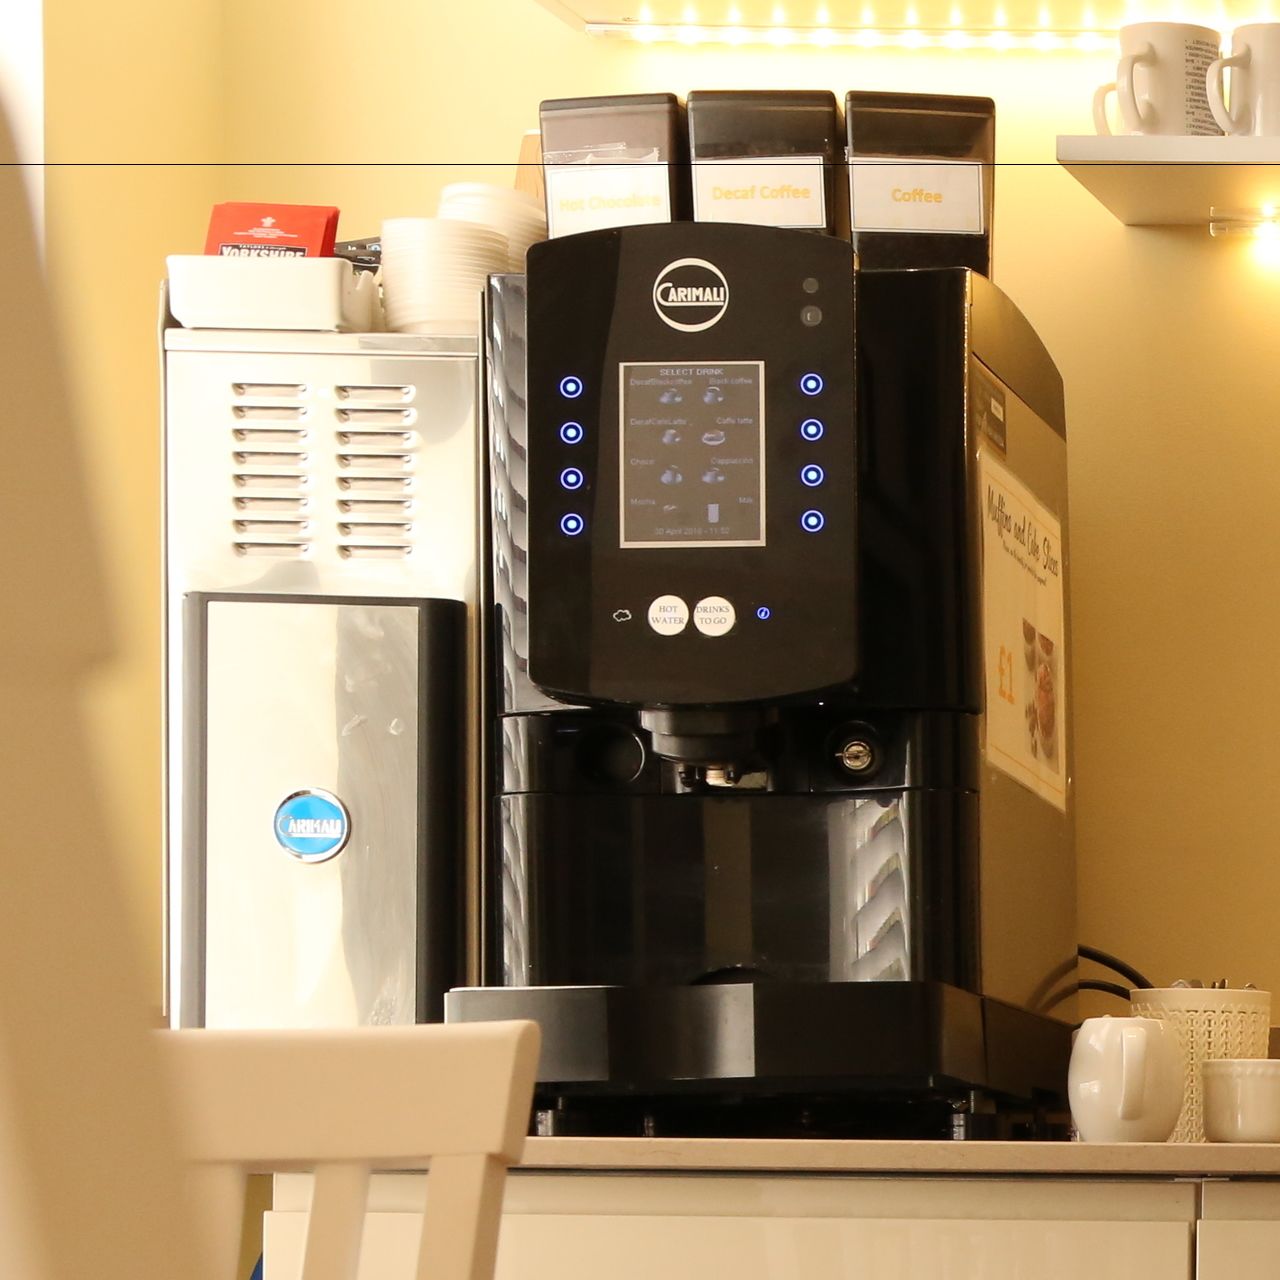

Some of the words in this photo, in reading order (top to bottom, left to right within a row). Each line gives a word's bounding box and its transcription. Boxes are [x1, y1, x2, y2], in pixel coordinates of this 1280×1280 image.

[712, 184, 755, 201] Decaf
[759, 184, 811, 201] Coffee
[891, 187, 943, 204] Coffee
[559, 196, 585, 212] Hot
[656, 282, 725, 306] CARIMALI
[659, 368, 693, 376] SELECT
[696, 368, 724, 376] DRINK
[658, 605, 678, 613] HOT
[695, 606, 730, 614] DRINKS
[651, 617, 685, 625] WATER
[699, 617, 712, 625] TO
[712, 617, 727, 625] GO
